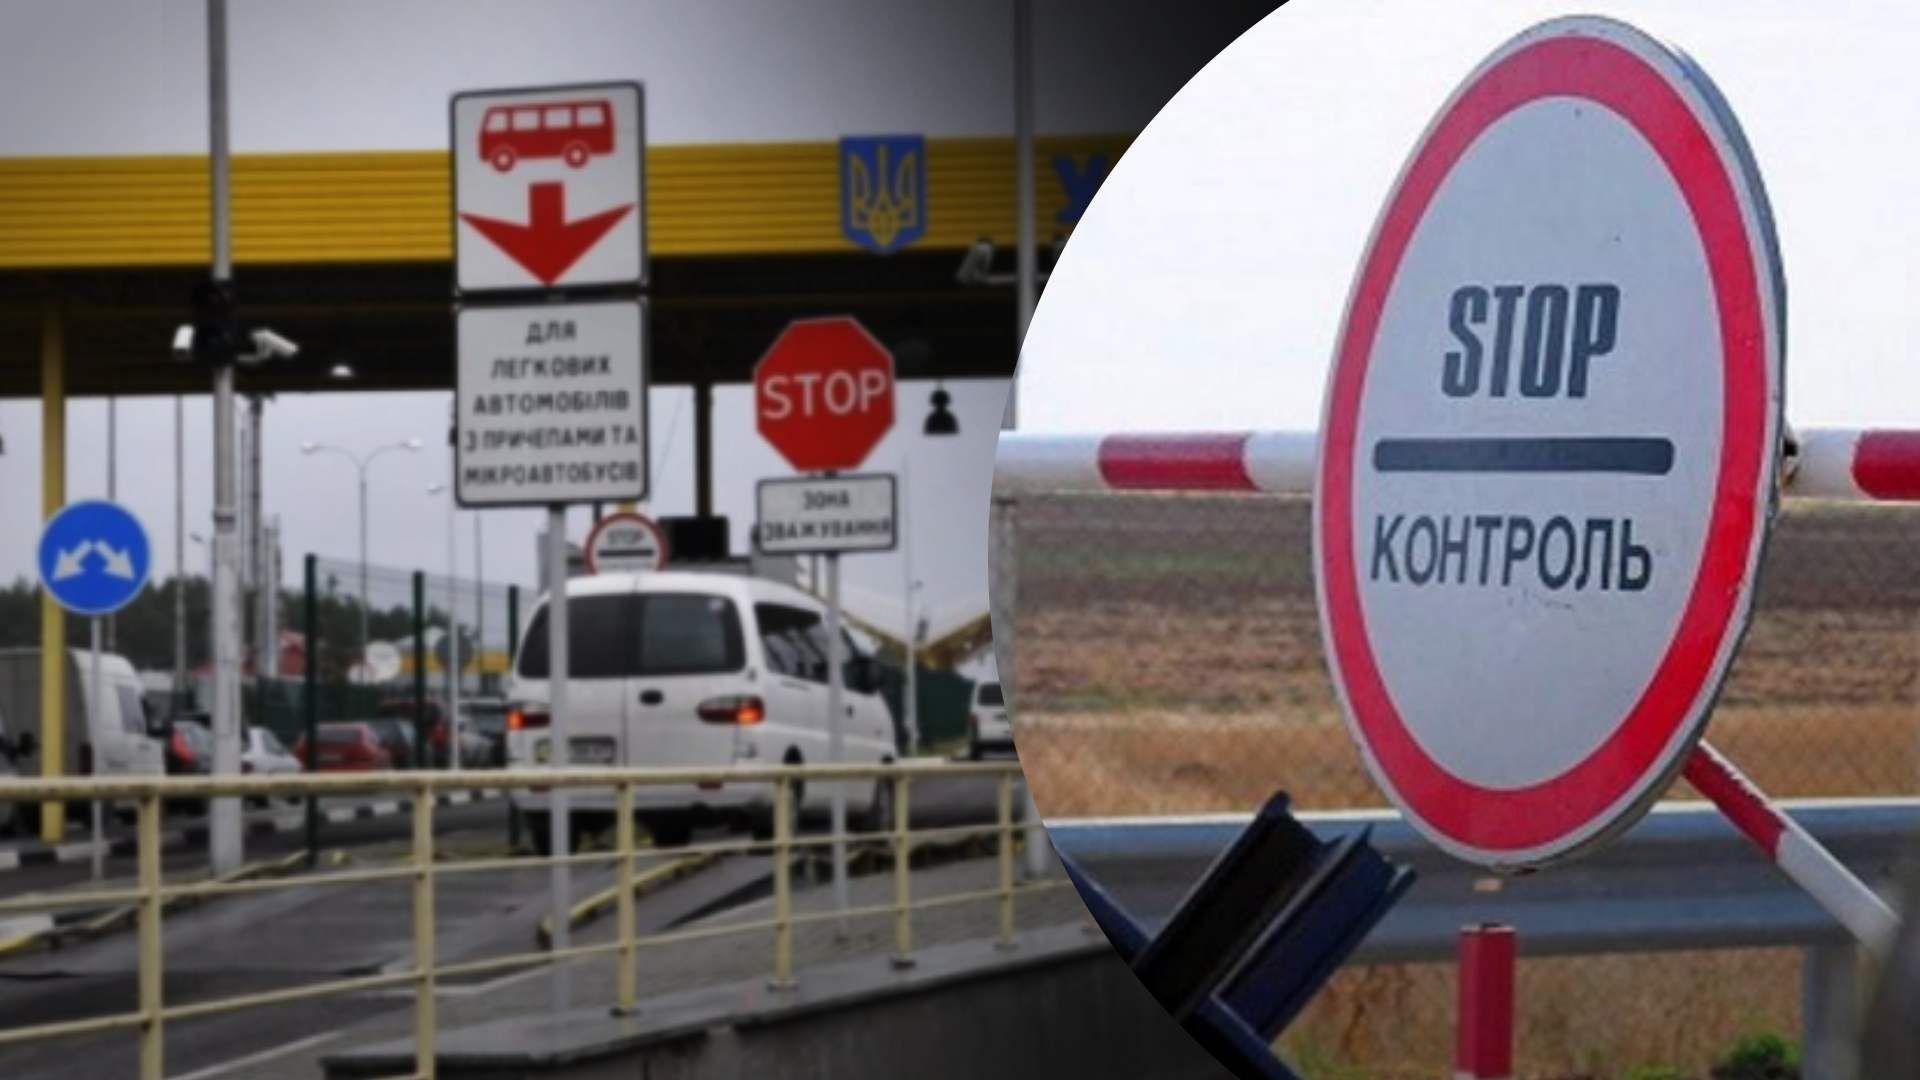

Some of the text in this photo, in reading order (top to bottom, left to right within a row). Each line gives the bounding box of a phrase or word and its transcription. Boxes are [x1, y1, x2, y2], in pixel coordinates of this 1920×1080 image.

[526, 320, 577, 345] ДЛЯ
[1441, 283, 1621, 399] STOP
[491, 355, 612, 379] ЛЕГКОВИХ
[473, 390, 630, 415] АВТОМОБІЛІВ
[762, 369, 887, 420] STOP
[465, 425, 637, 452] З ПРИЧЕПАМИ ТА
[464, 461, 638, 485] МІКРОАВТОБУСІВ
[803, 490, 850, 510] ЗОНА
[763, 520, 892, 542] ЗВАЖУВАННЯ
[1370, 514, 1653, 591] КОНТРОЛЬ
